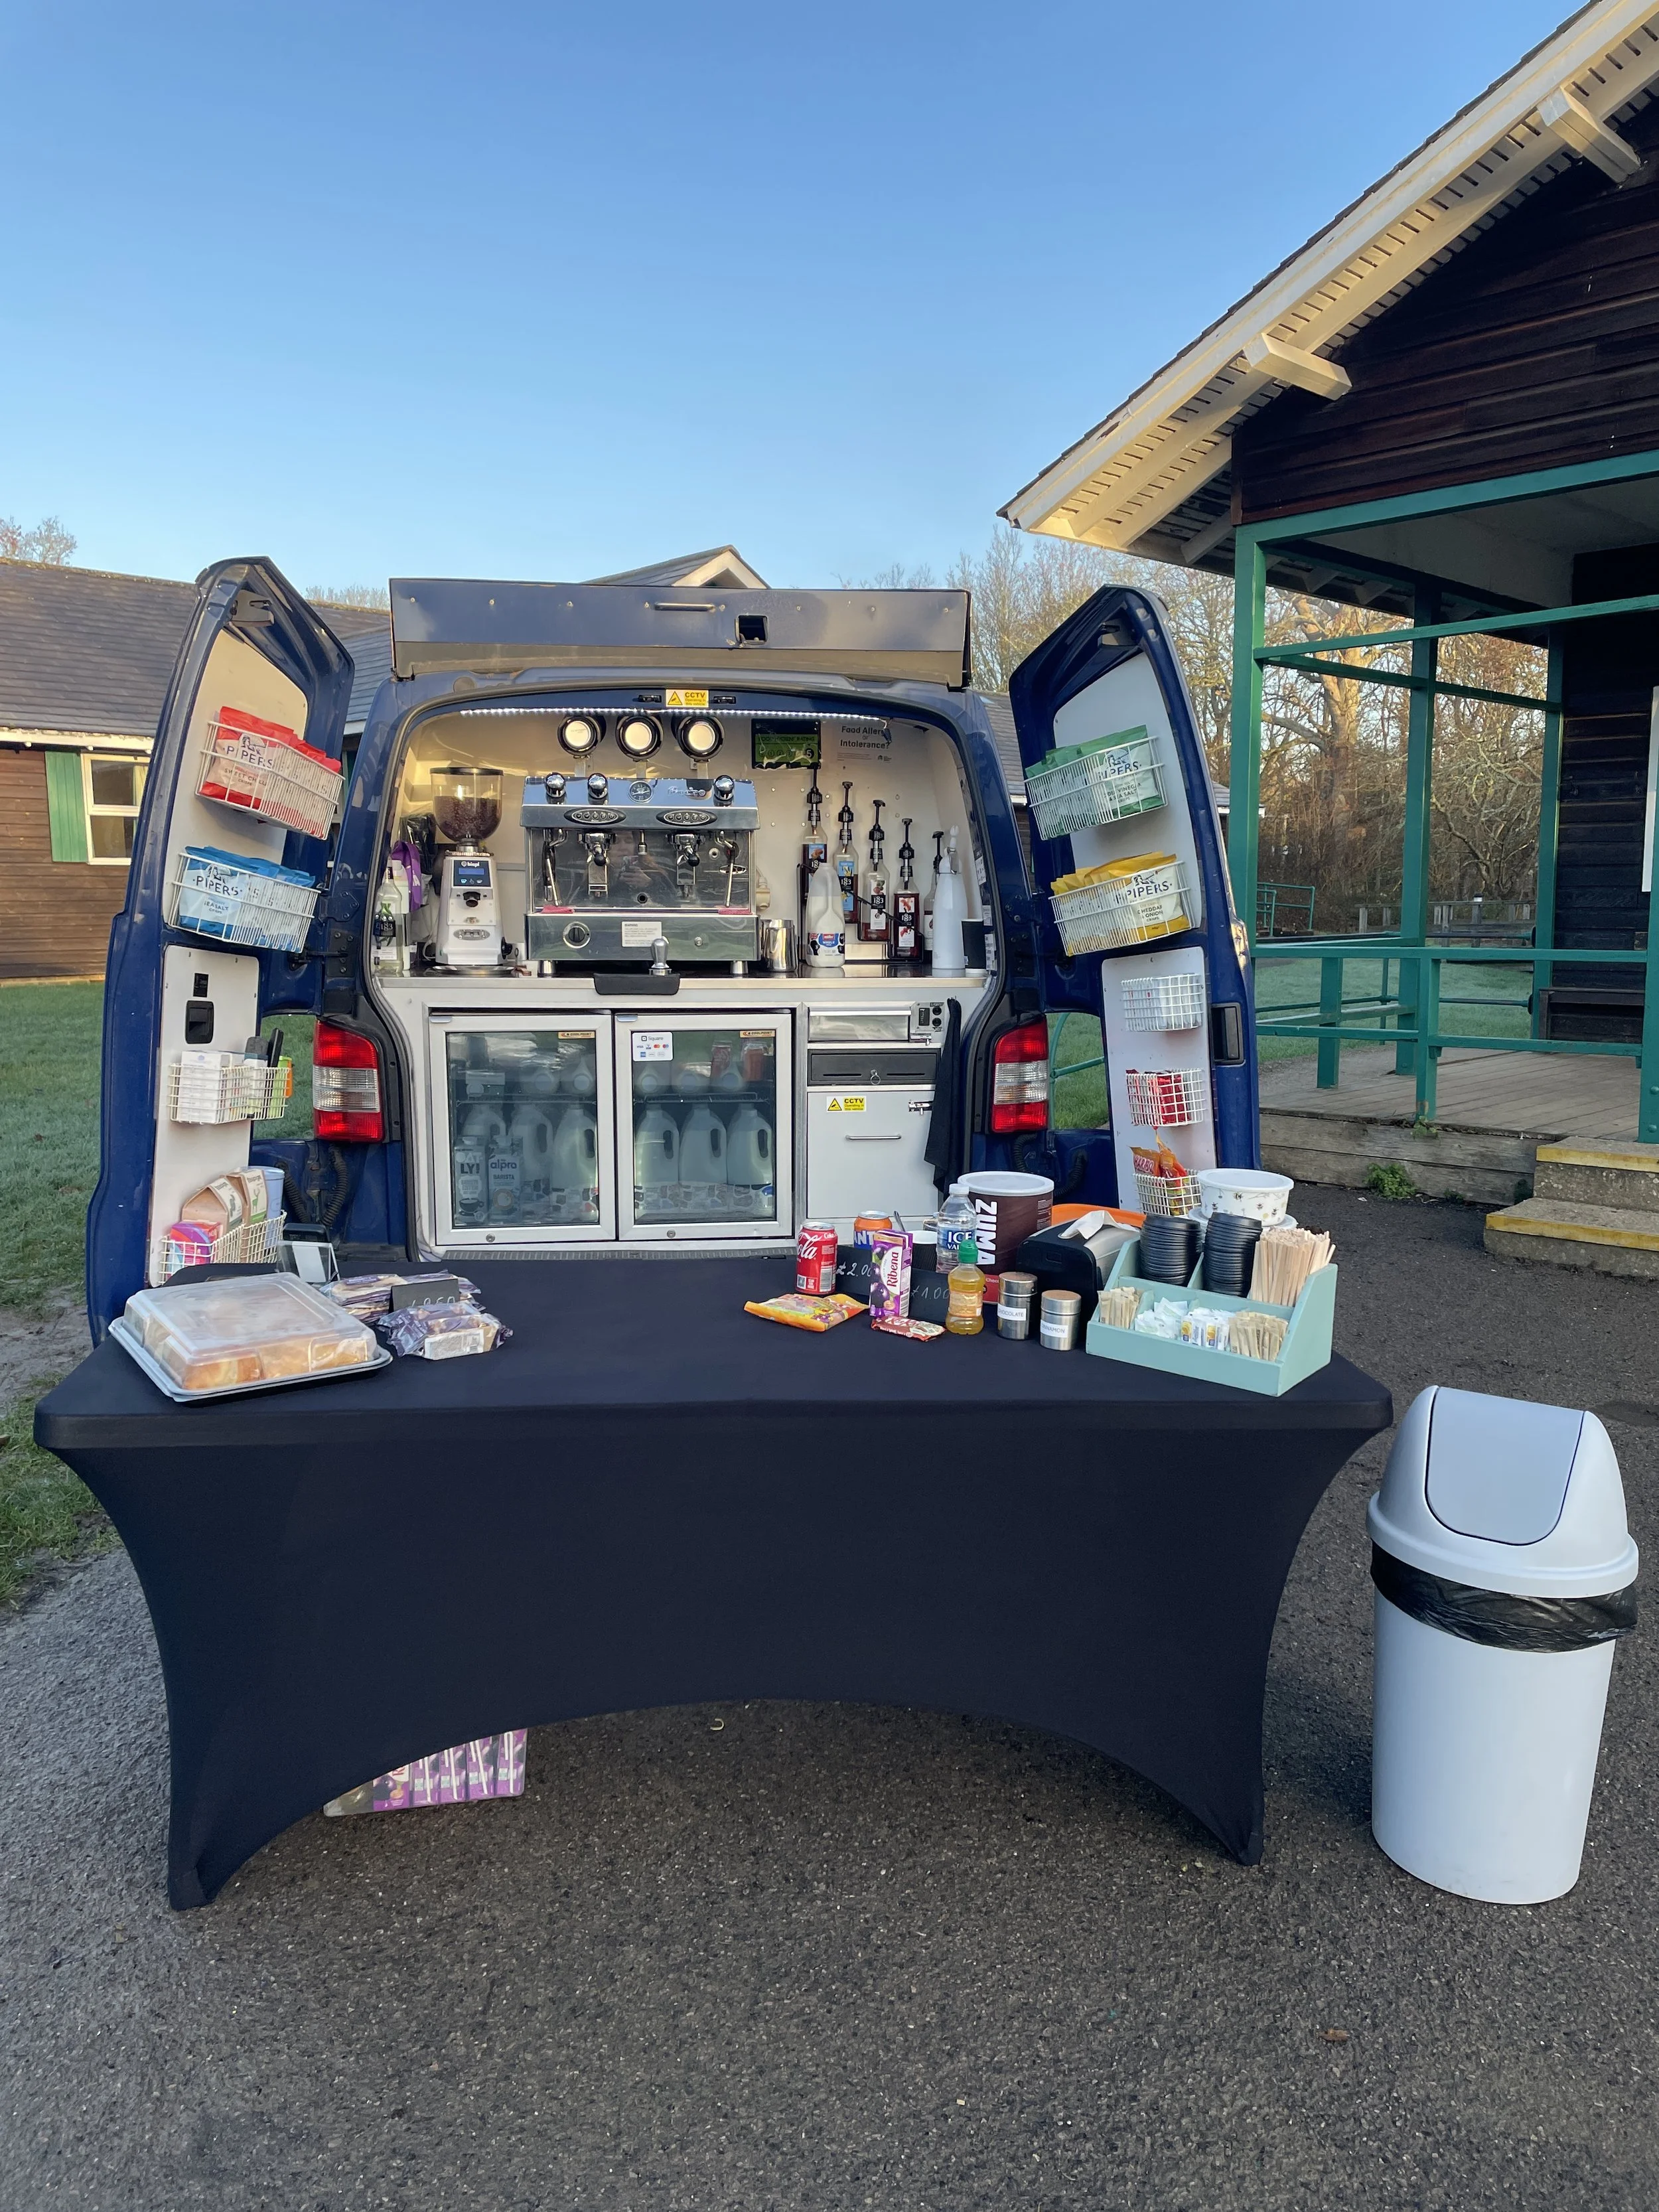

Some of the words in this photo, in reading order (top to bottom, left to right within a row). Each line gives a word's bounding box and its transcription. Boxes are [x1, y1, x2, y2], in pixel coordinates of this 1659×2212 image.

[841, 725, 861, 734] Food
[840, 739, 891, 749] Intolerance?
[248, 776, 267, 786] CHLLI
[196, 875, 240, 897] PIPERS
[1127, 880, 1170, 899] PIPERS
[460, 1162, 480, 1174] LY!
[490, 1159, 517, 1171] alpro
[854, 1230, 875, 1245] ANT
[948, 1231, 972, 1243] ICE
[975, 1199, 997, 1265] ZUMA
[887, 1252, 899, 1287] Ribena
[998, 1307, 1024, 1317] CHOCOLATE
[1041, 1323, 1065, 1333] CINNAMON
